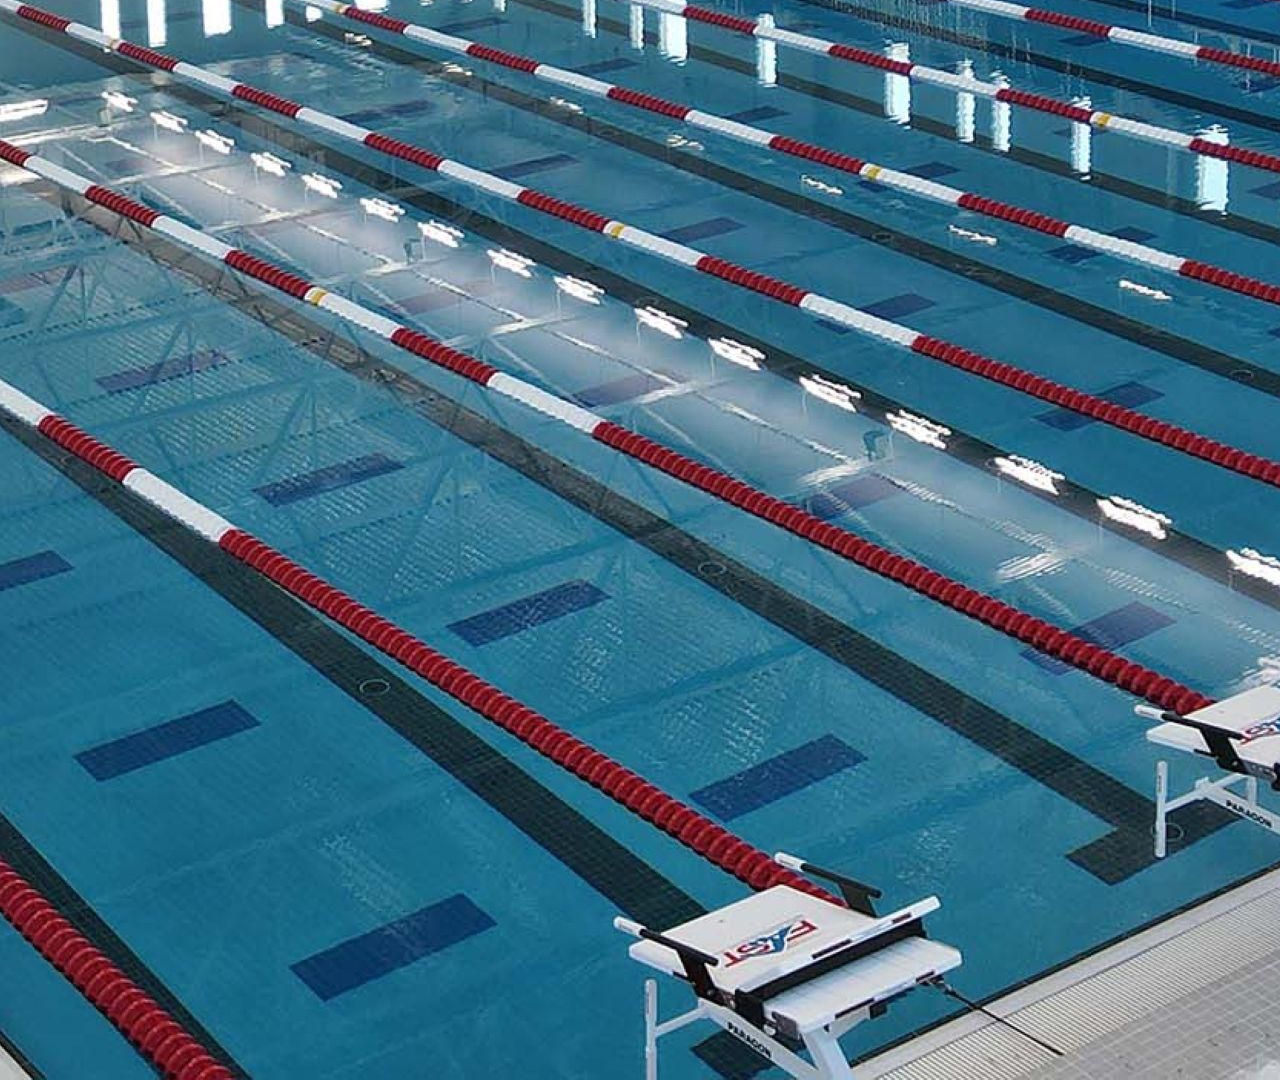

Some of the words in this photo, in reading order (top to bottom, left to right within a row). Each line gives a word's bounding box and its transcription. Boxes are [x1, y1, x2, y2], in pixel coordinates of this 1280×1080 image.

[1225, 799, 1273, 829] PARAGON
[723, 919, 819, 969] FAST
[726, 1021, 774, 1059] PARAGON
